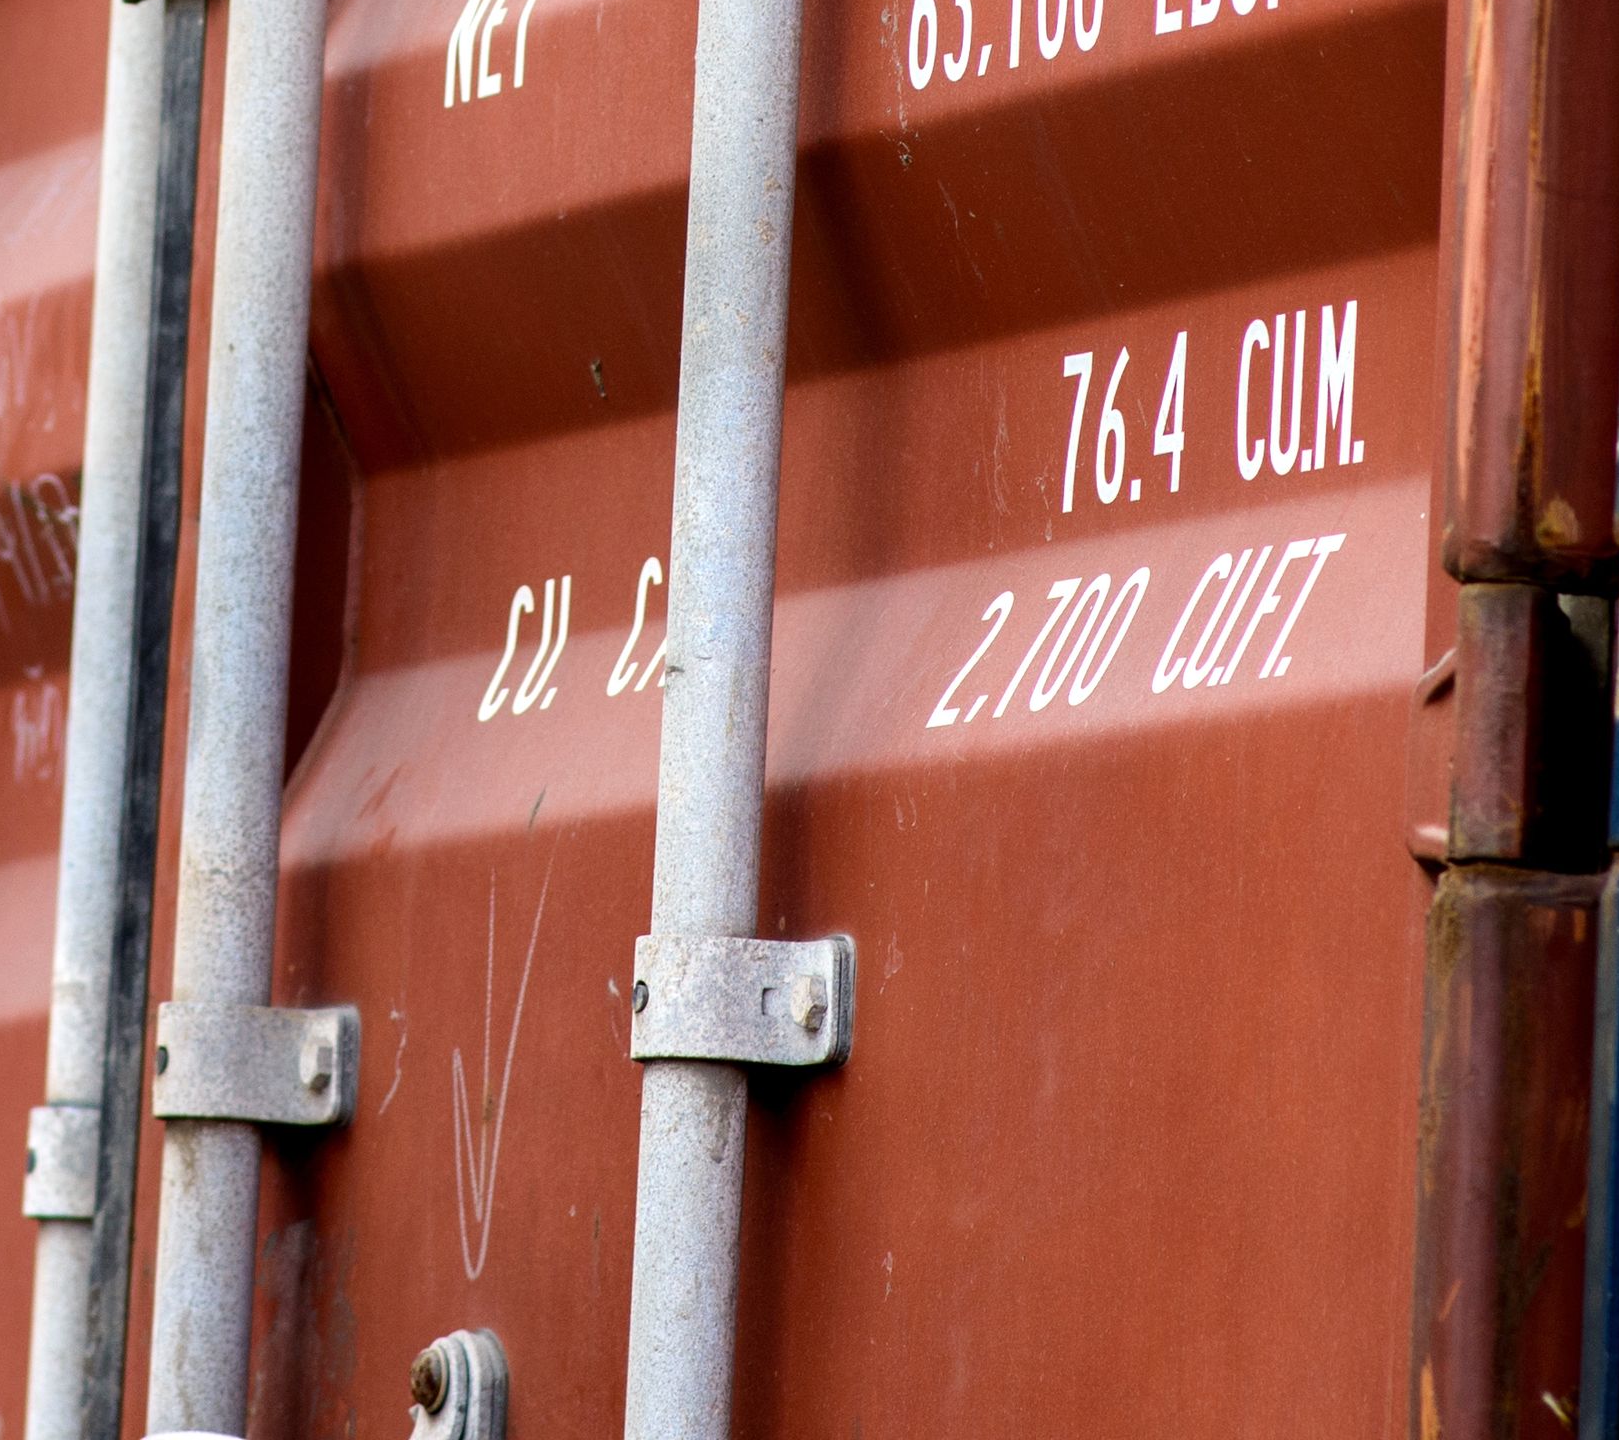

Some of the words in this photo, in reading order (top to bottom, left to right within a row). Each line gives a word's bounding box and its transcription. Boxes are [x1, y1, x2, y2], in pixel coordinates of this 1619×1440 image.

[1061, 330, 1188, 514] 76.4
[1236, 299, 1365, 481] CU.M.
[477, 574, 571, 722] CU.
[924, 566, 1152, 729] 2,700
